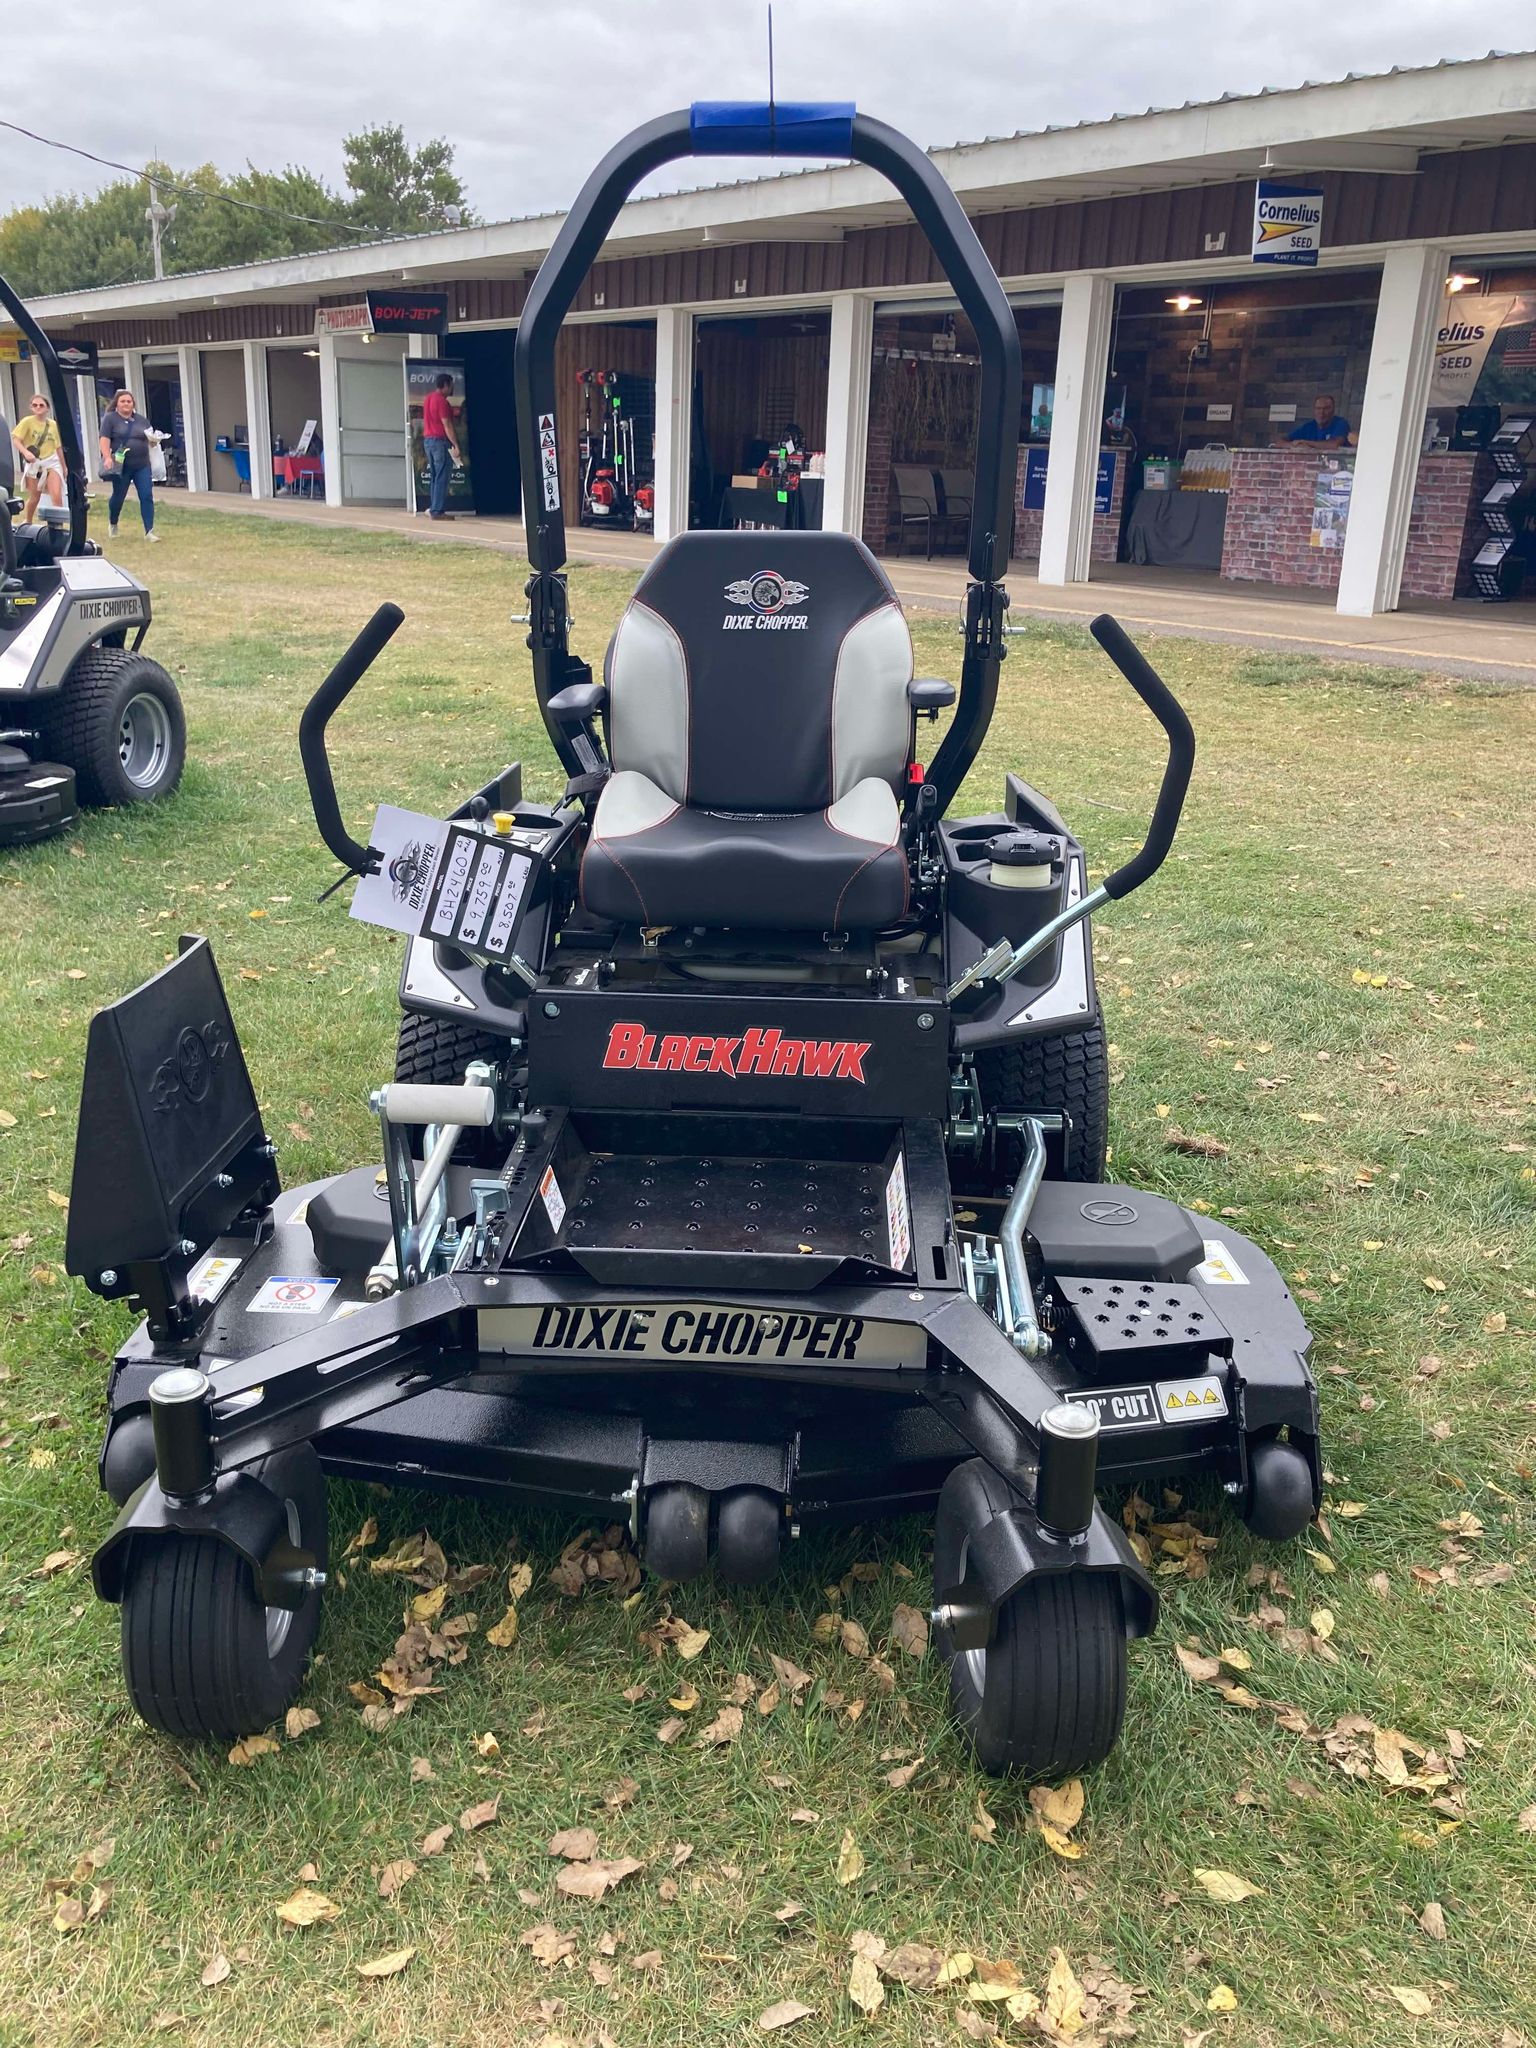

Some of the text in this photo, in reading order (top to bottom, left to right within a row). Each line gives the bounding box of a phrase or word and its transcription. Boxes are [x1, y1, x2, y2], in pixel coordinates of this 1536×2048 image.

[1258, 200, 1320, 223] Cornelius
[1290, 236, 1313, 249] SEED
[374, 306, 436, 320] BOVI-JET
[1437, 321, 1486, 342] elius
[1440, 356, 1472, 369] SEED
[80, 599, 138, 620] DIXIE CHOPPER
[722, 615, 808, 630] DIXIE CHOPPER
[409, 843, 436, 910] DIXIE CHOPPER
[440, 856, 468, 921] BH2460
[463, 928, 477, 939] $
[490, 937, 503, 948] $
[532, 1306, 865, 1361] DIXIE CHOPPER
[1111, 1393, 1150, 1419] CUT
